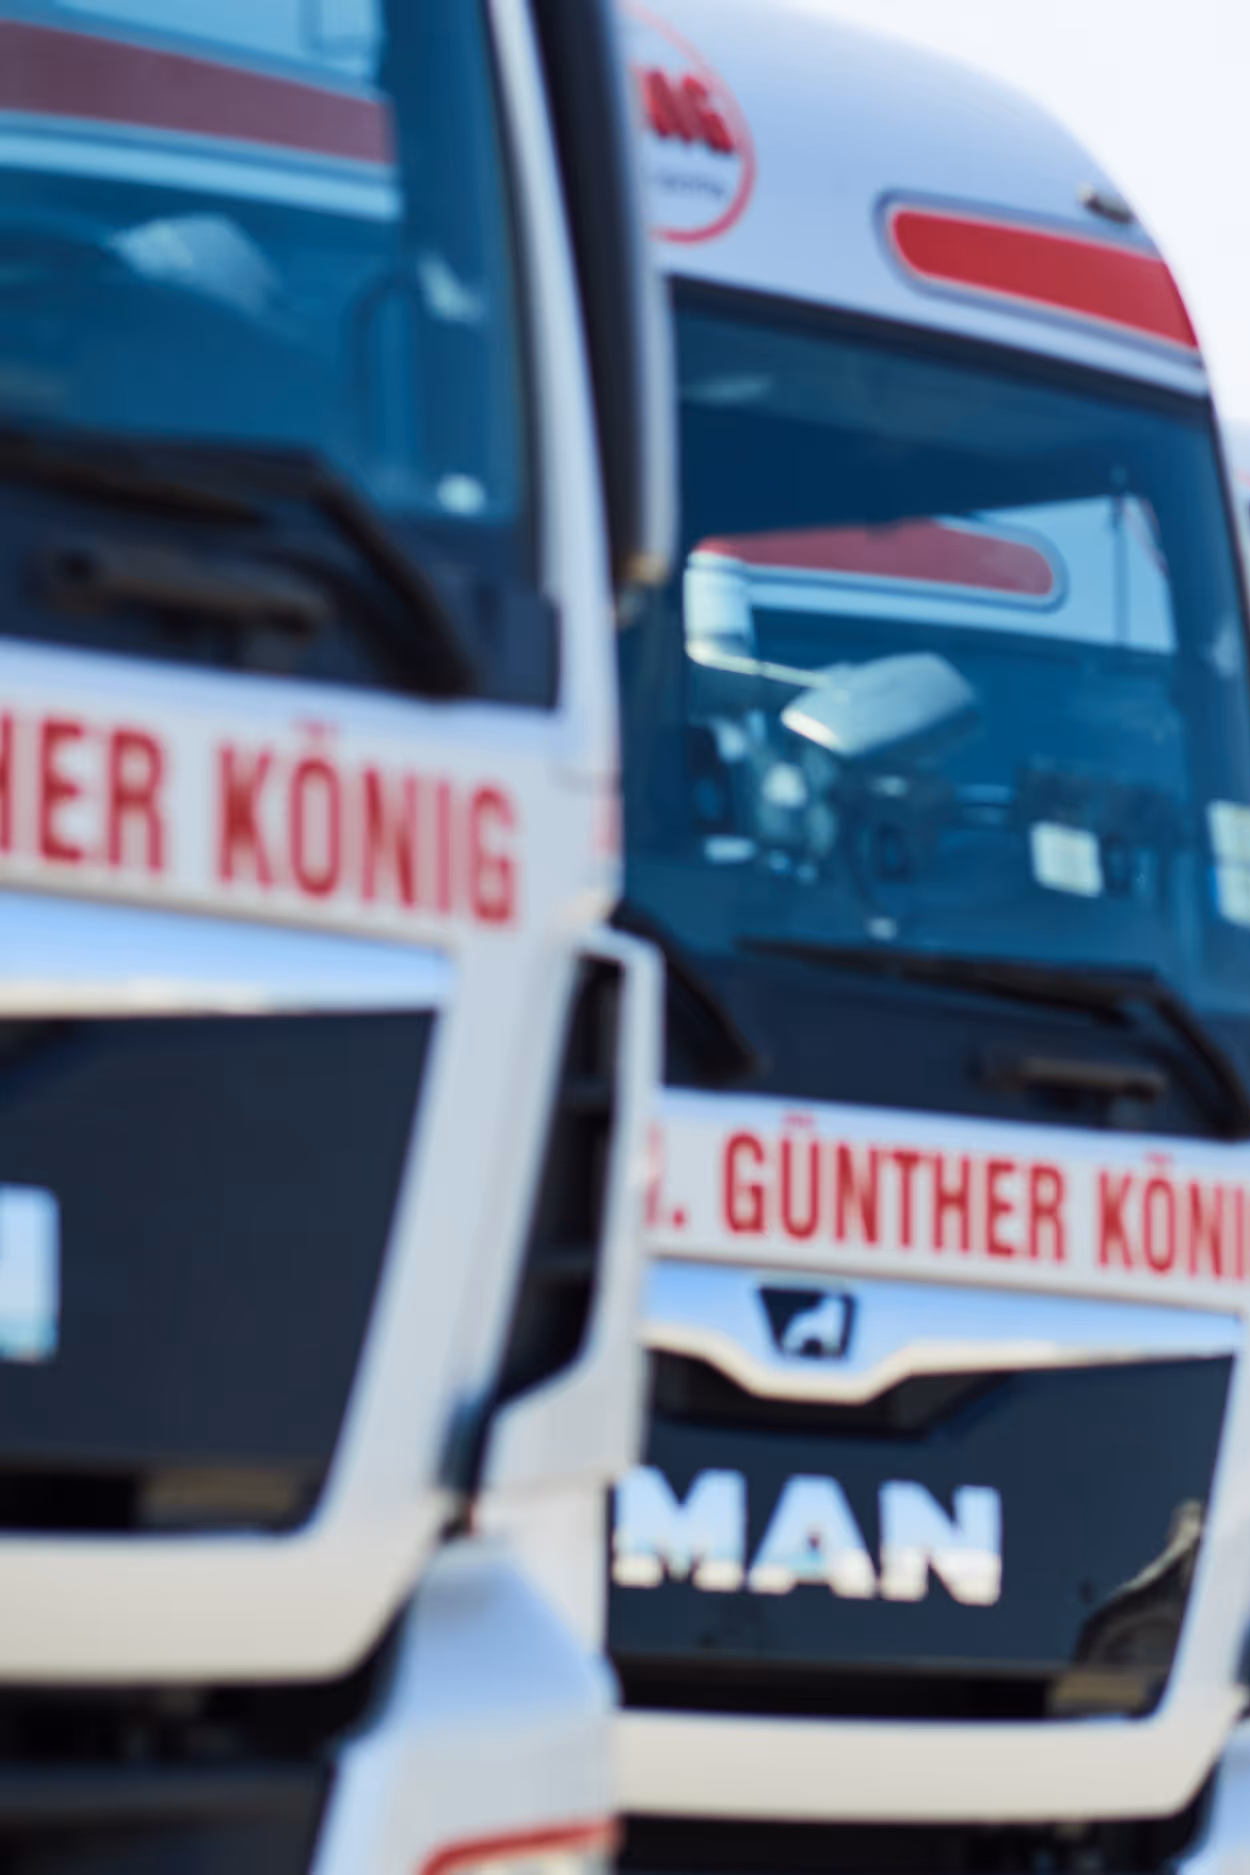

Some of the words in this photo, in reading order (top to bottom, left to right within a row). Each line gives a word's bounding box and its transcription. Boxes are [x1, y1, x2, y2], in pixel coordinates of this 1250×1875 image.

[0, 714, 165, 873] ER
[217, 718, 518, 925] KÖNIG
[722, 1112, 1067, 1265] GÜNTHER
[612, 1464, 1002, 1606] MAN
